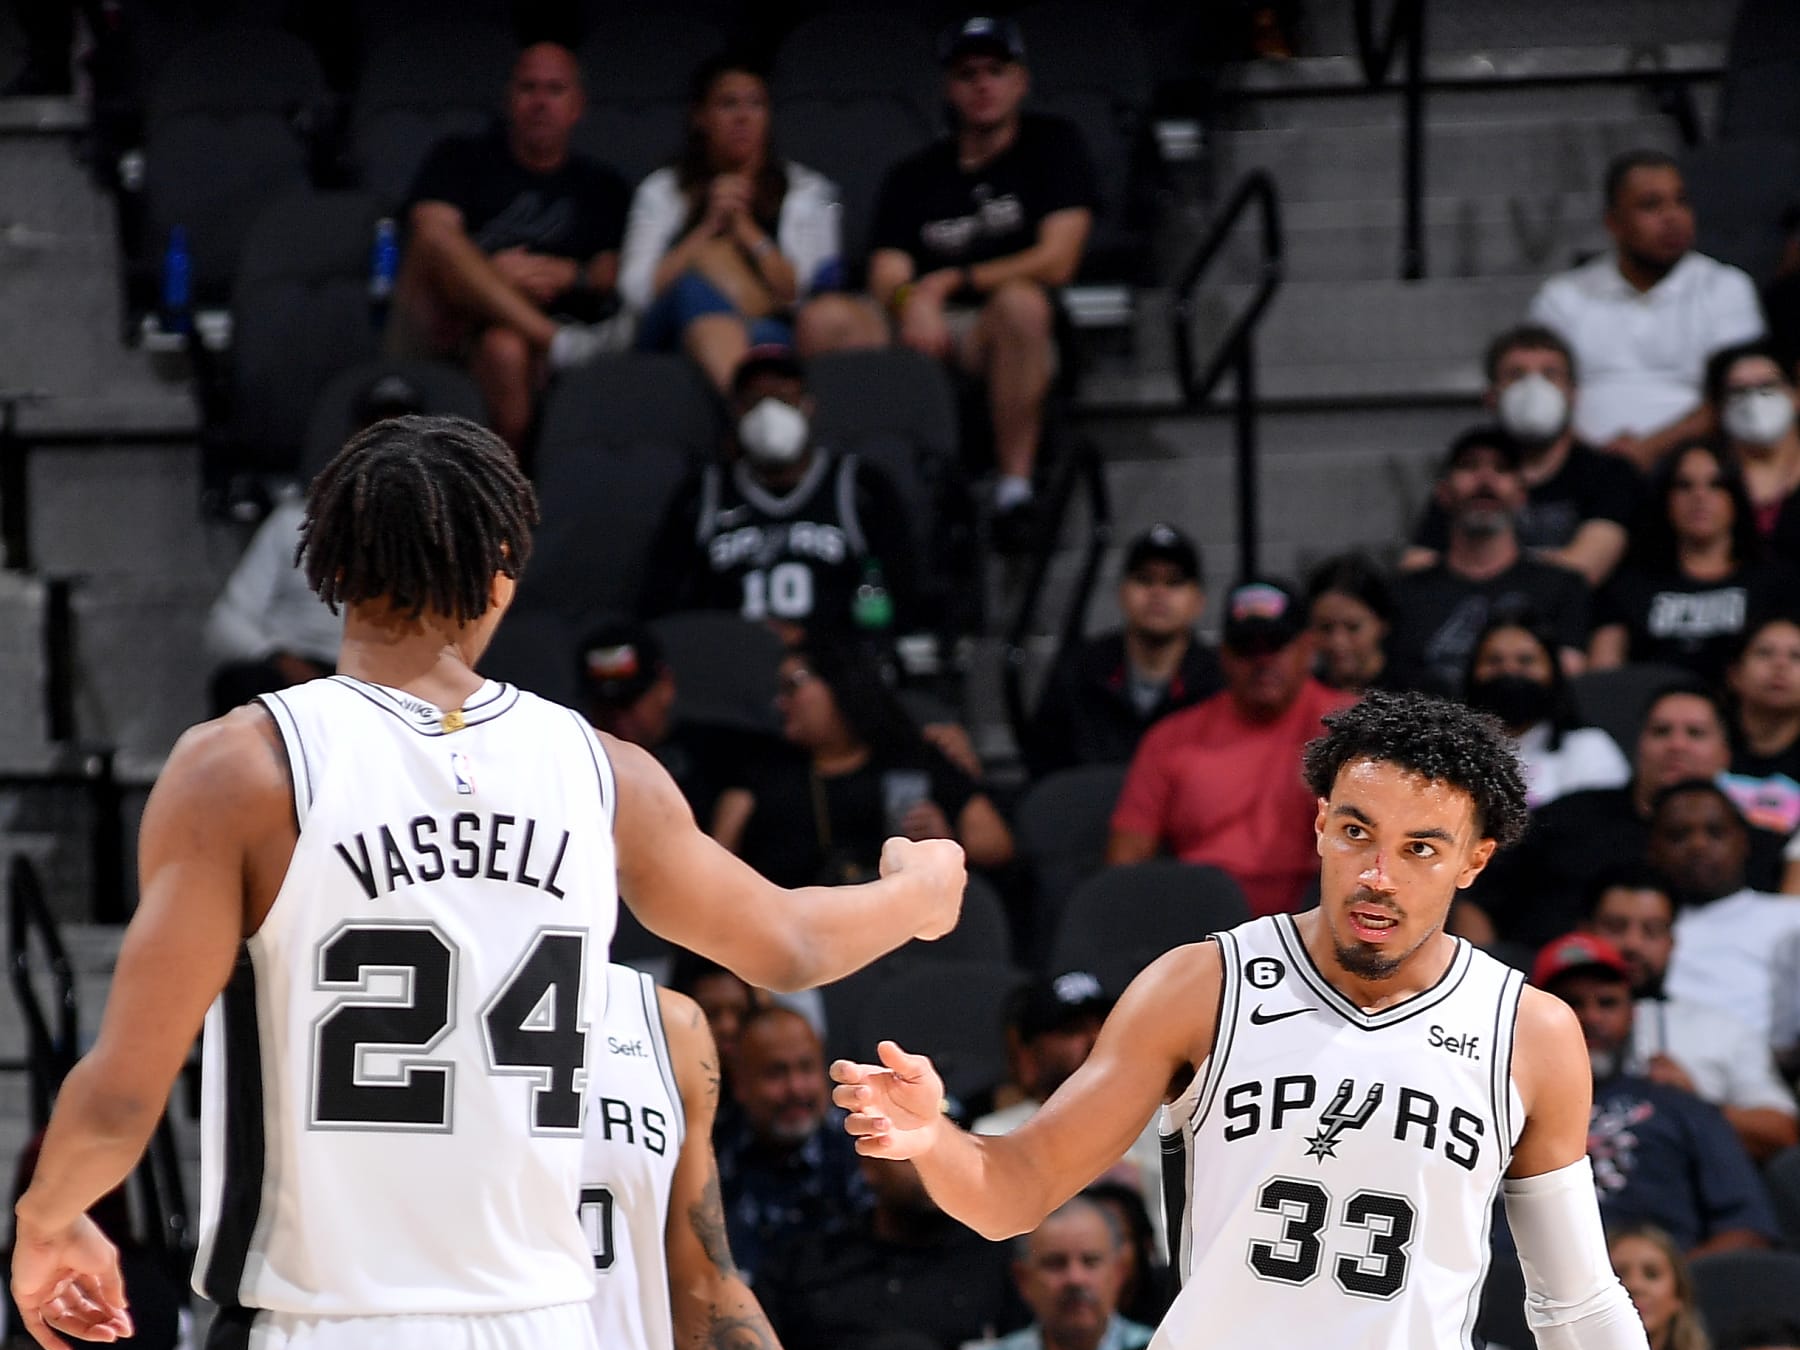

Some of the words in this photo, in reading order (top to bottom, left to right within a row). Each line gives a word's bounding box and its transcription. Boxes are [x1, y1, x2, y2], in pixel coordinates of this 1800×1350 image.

[741, 562, 814, 622] 10
[333, 811, 570, 900] VASSELL
[1252, 961, 1277, 986] 6
[307, 918, 590, 1139] 24
[1427, 1025, 1481, 1062] Self.
[1223, 1073, 1485, 1172] SPURS
[1246, 1174, 1419, 1302] 33
